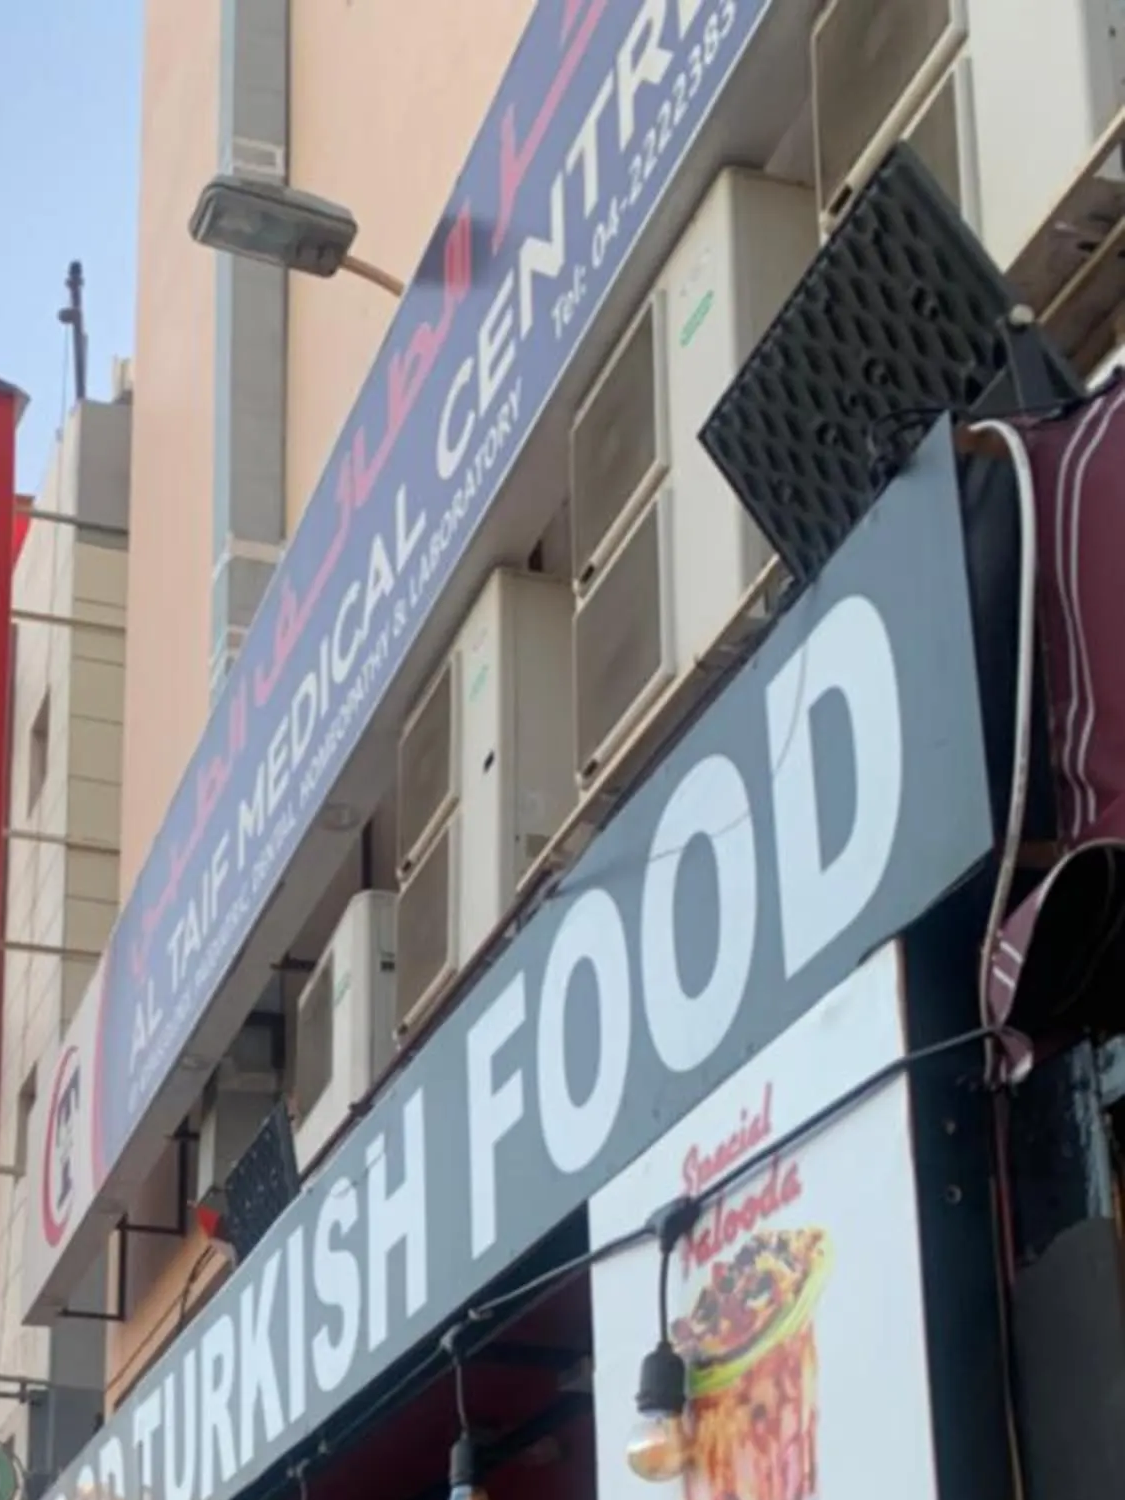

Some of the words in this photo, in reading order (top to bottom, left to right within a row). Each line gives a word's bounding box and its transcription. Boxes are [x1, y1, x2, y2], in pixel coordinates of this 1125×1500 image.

[128, 977, 164, 1073] AL
[167, 828, 230, 996] TAIF
[237, 484, 426, 873] MEDICAL
[437, 0, 702, 480] CENTR
[409, 377, 523, 603] LABORATORY
[467, 595, 903, 1262] FOOD
